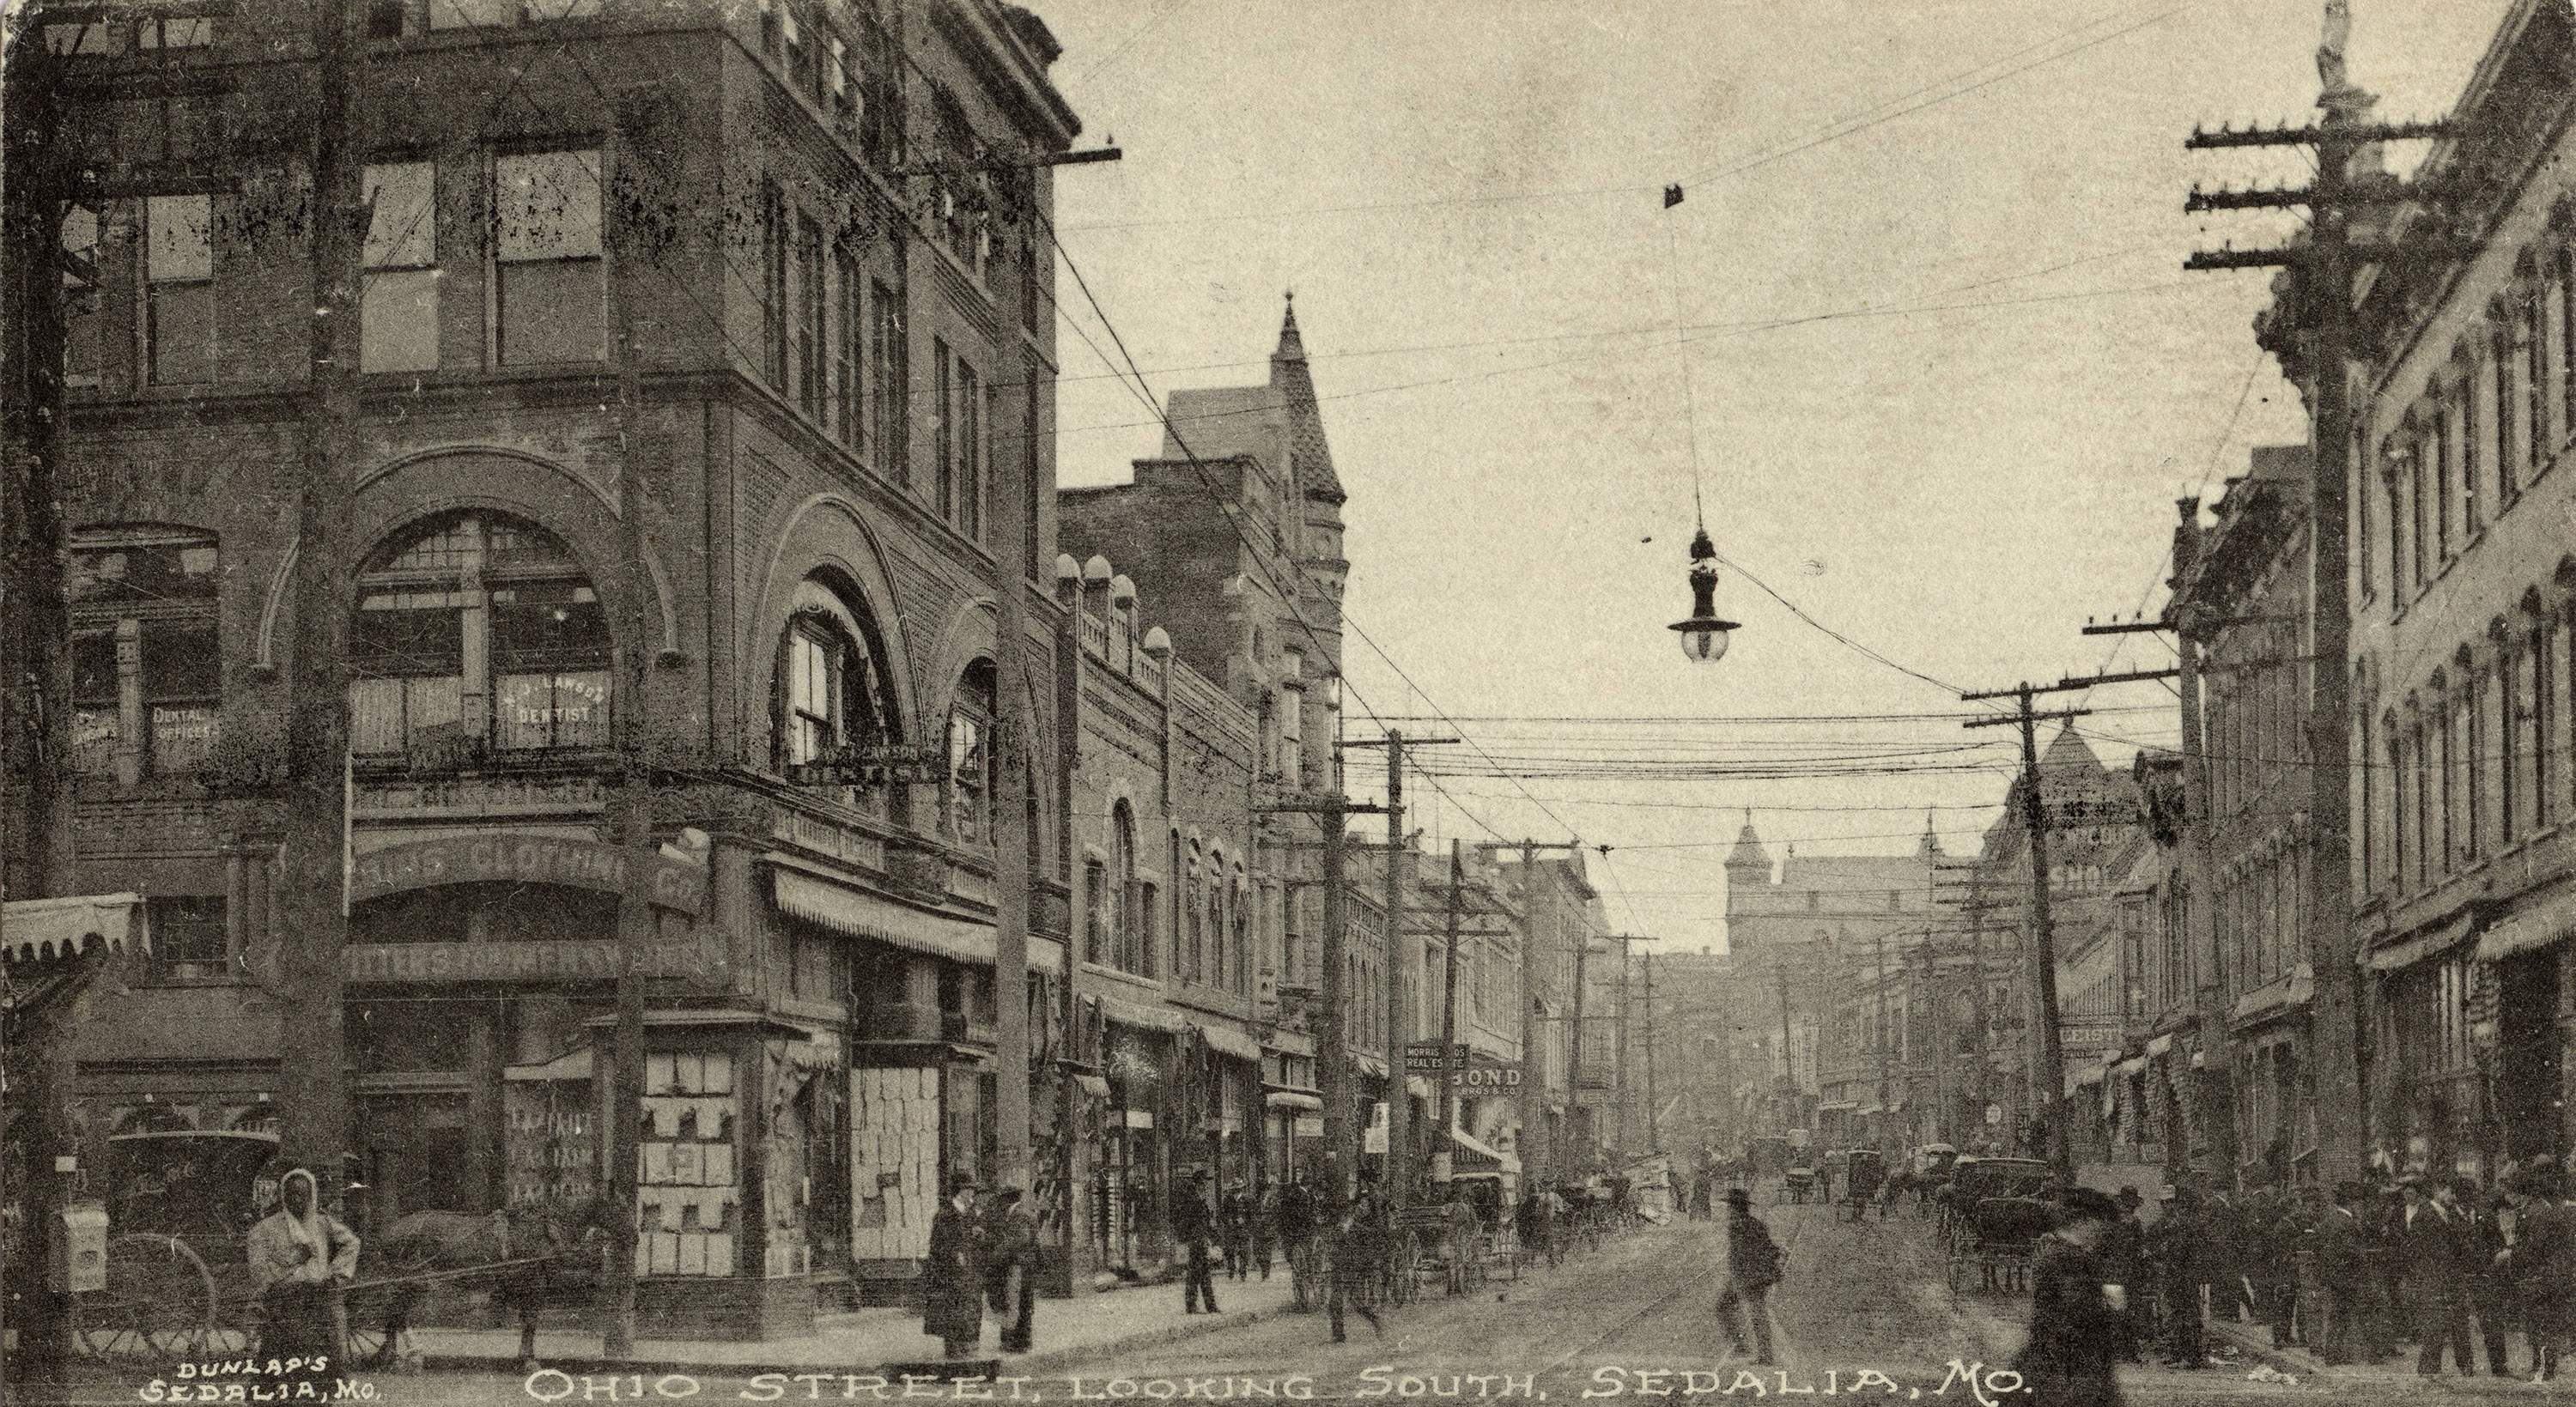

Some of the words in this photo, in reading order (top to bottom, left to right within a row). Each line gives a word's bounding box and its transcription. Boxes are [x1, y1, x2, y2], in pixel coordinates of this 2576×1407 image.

[153, 707, 205, 724] DENTAL
[519, 707, 589, 723] DENTIST
[1406, 1047, 1440, 1057] MORRIS
[1406, 1058, 1429, 1068] REAL
[1431, 1058, 1465, 1069] ESTE
[1461, 1087, 1490, 1095] BROS
[1492, 1087, 1499, 1095] &
